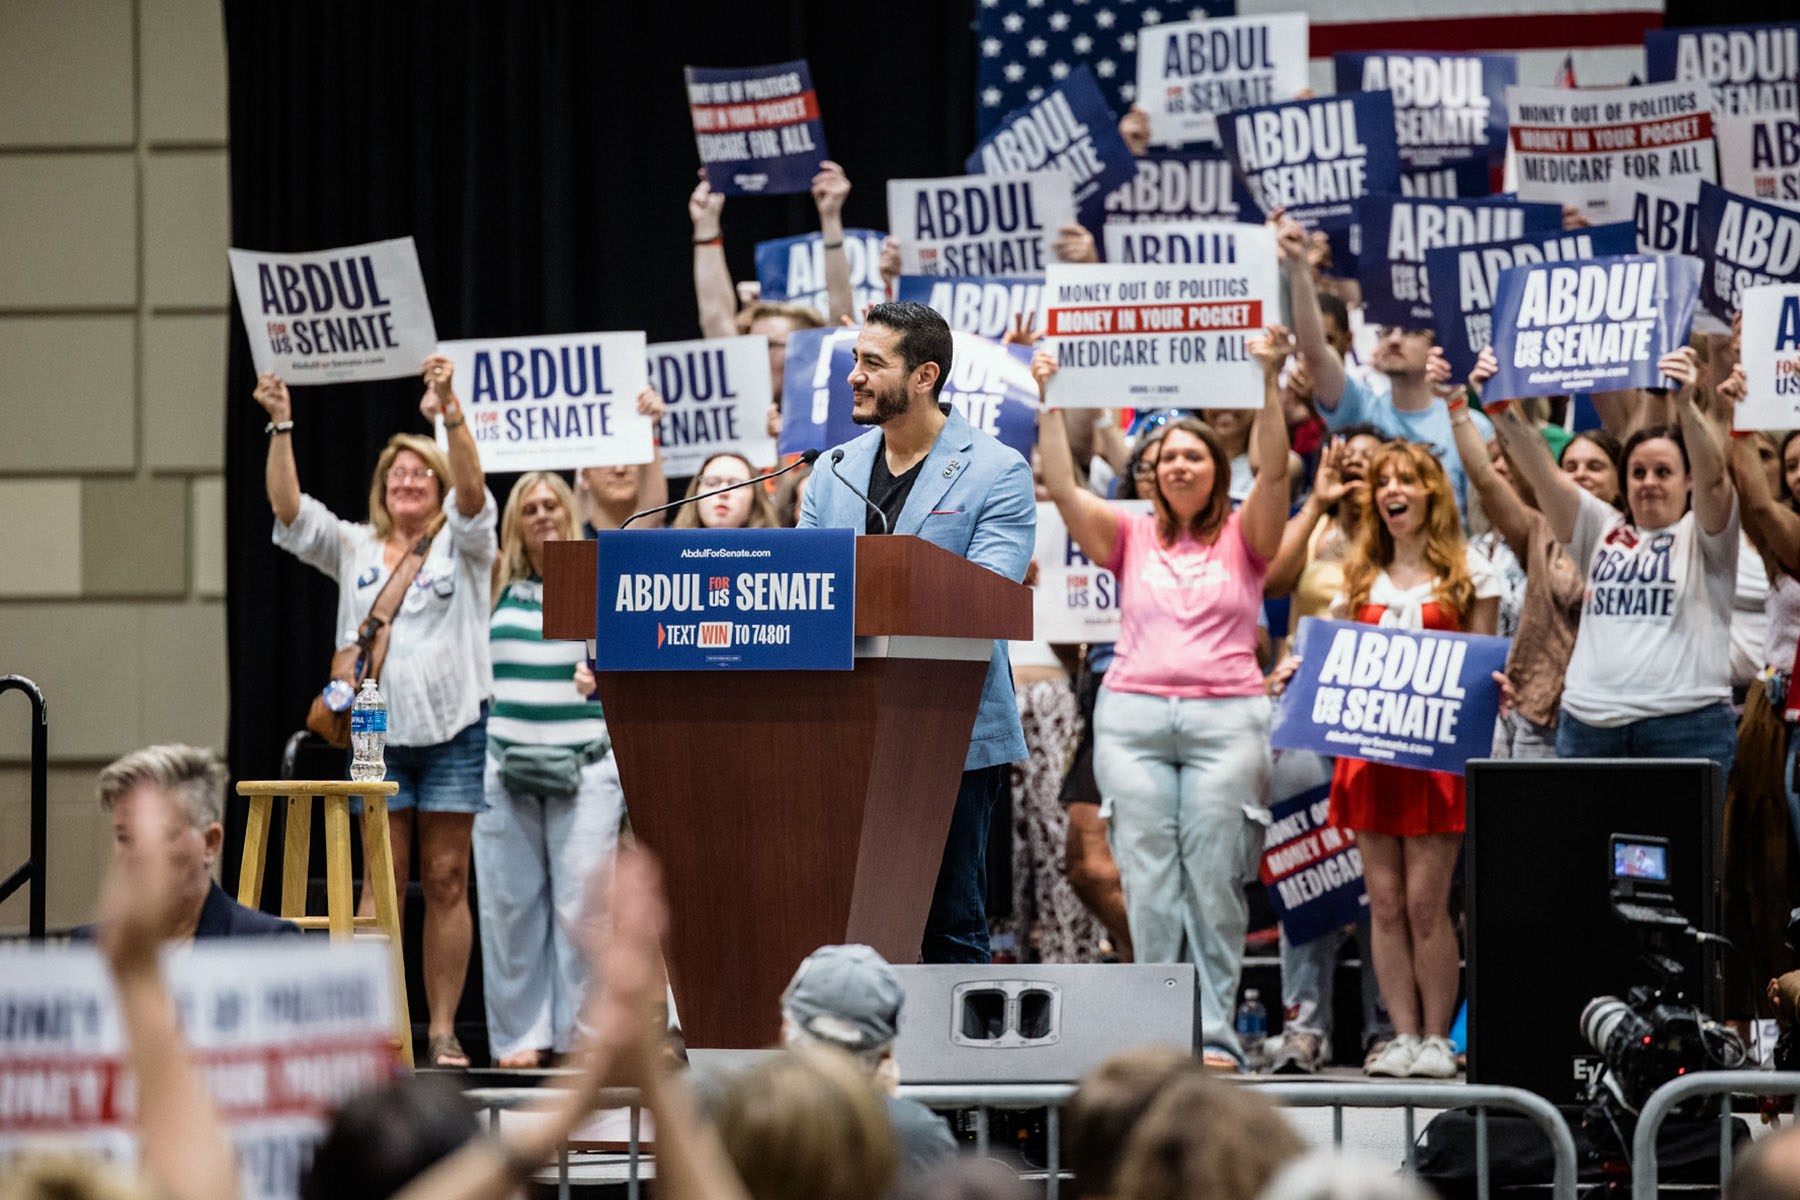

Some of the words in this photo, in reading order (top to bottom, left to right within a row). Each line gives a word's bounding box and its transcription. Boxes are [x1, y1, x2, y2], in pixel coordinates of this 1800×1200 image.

[1164, 26, 1274, 79] ABDUL
[1189, 77, 1274, 114] SENATE
[1361, 55, 1490, 109] ABDUL
[1629, 92, 1697, 118] POLITICS
[781, 123, 816, 155] ALL
[982, 89, 1090, 176] ABDUL
[1235, 99, 1368, 174] ABDUL
[1640, 117, 1699, 147] POCKET
[1261, 157, 1369, 207] SENATE
[1524, 157, 1613, 183] MEDICARE
[1623, 150, 1660, 178] FOR
[1670, 147, 1702, 175] ALL
[915, 181, 1044, 240] ABDUL
[944, 237, 1046, 277] SENATE
[258, 255, 391, 316] ABDUL
[1058, 283, 1111, 303] MONEY
[1118, 281, 1147, 301] OUT
[1154, 280, 1171, 299] OF
[1179, 278, 1249, 298] POLITICS
[1517, 263, 1658, 328] ABDUL
[292, 312, 400, 356] SENATE
[1056, 311, 1114, 333] MONEY
[1117, 308, 1137, 331] IN
[1139, 306, 1184, 330] YOUR
[1188, 304, 1250, 327] POCKET
[1057, 338, 1159, 368] MEDICARE
[1170, 336, 1207, 364] FOR
[1216, 335, 1250, 363] ALL
[1542, 320, 1655, 368] SENATE
[471, 343, 613, 403] ABDUL
[505, 402, 615, 443] SENATE
[680, 548, 771, 559] AbdulForSenate.com
[614, 573, 704, 612] ABDUL
[709, 576, 729, 590] FOR
[709, 589, 730, 607] US
[736, 572, 835, 611] SENATE
[1594, 587, 1674, 617] SENATE
[666, 624, 696, 645] TEXT
[701, 624, 728, 645] WIN
[735, 624, 750, 645] TO
[752, 624, 790, 645] 74801
[1318, 628, 1468, 699] ABDUL
[1342, 687, 1462, 745] SENATE
[1266, 833, 1322, 877] MONEY
